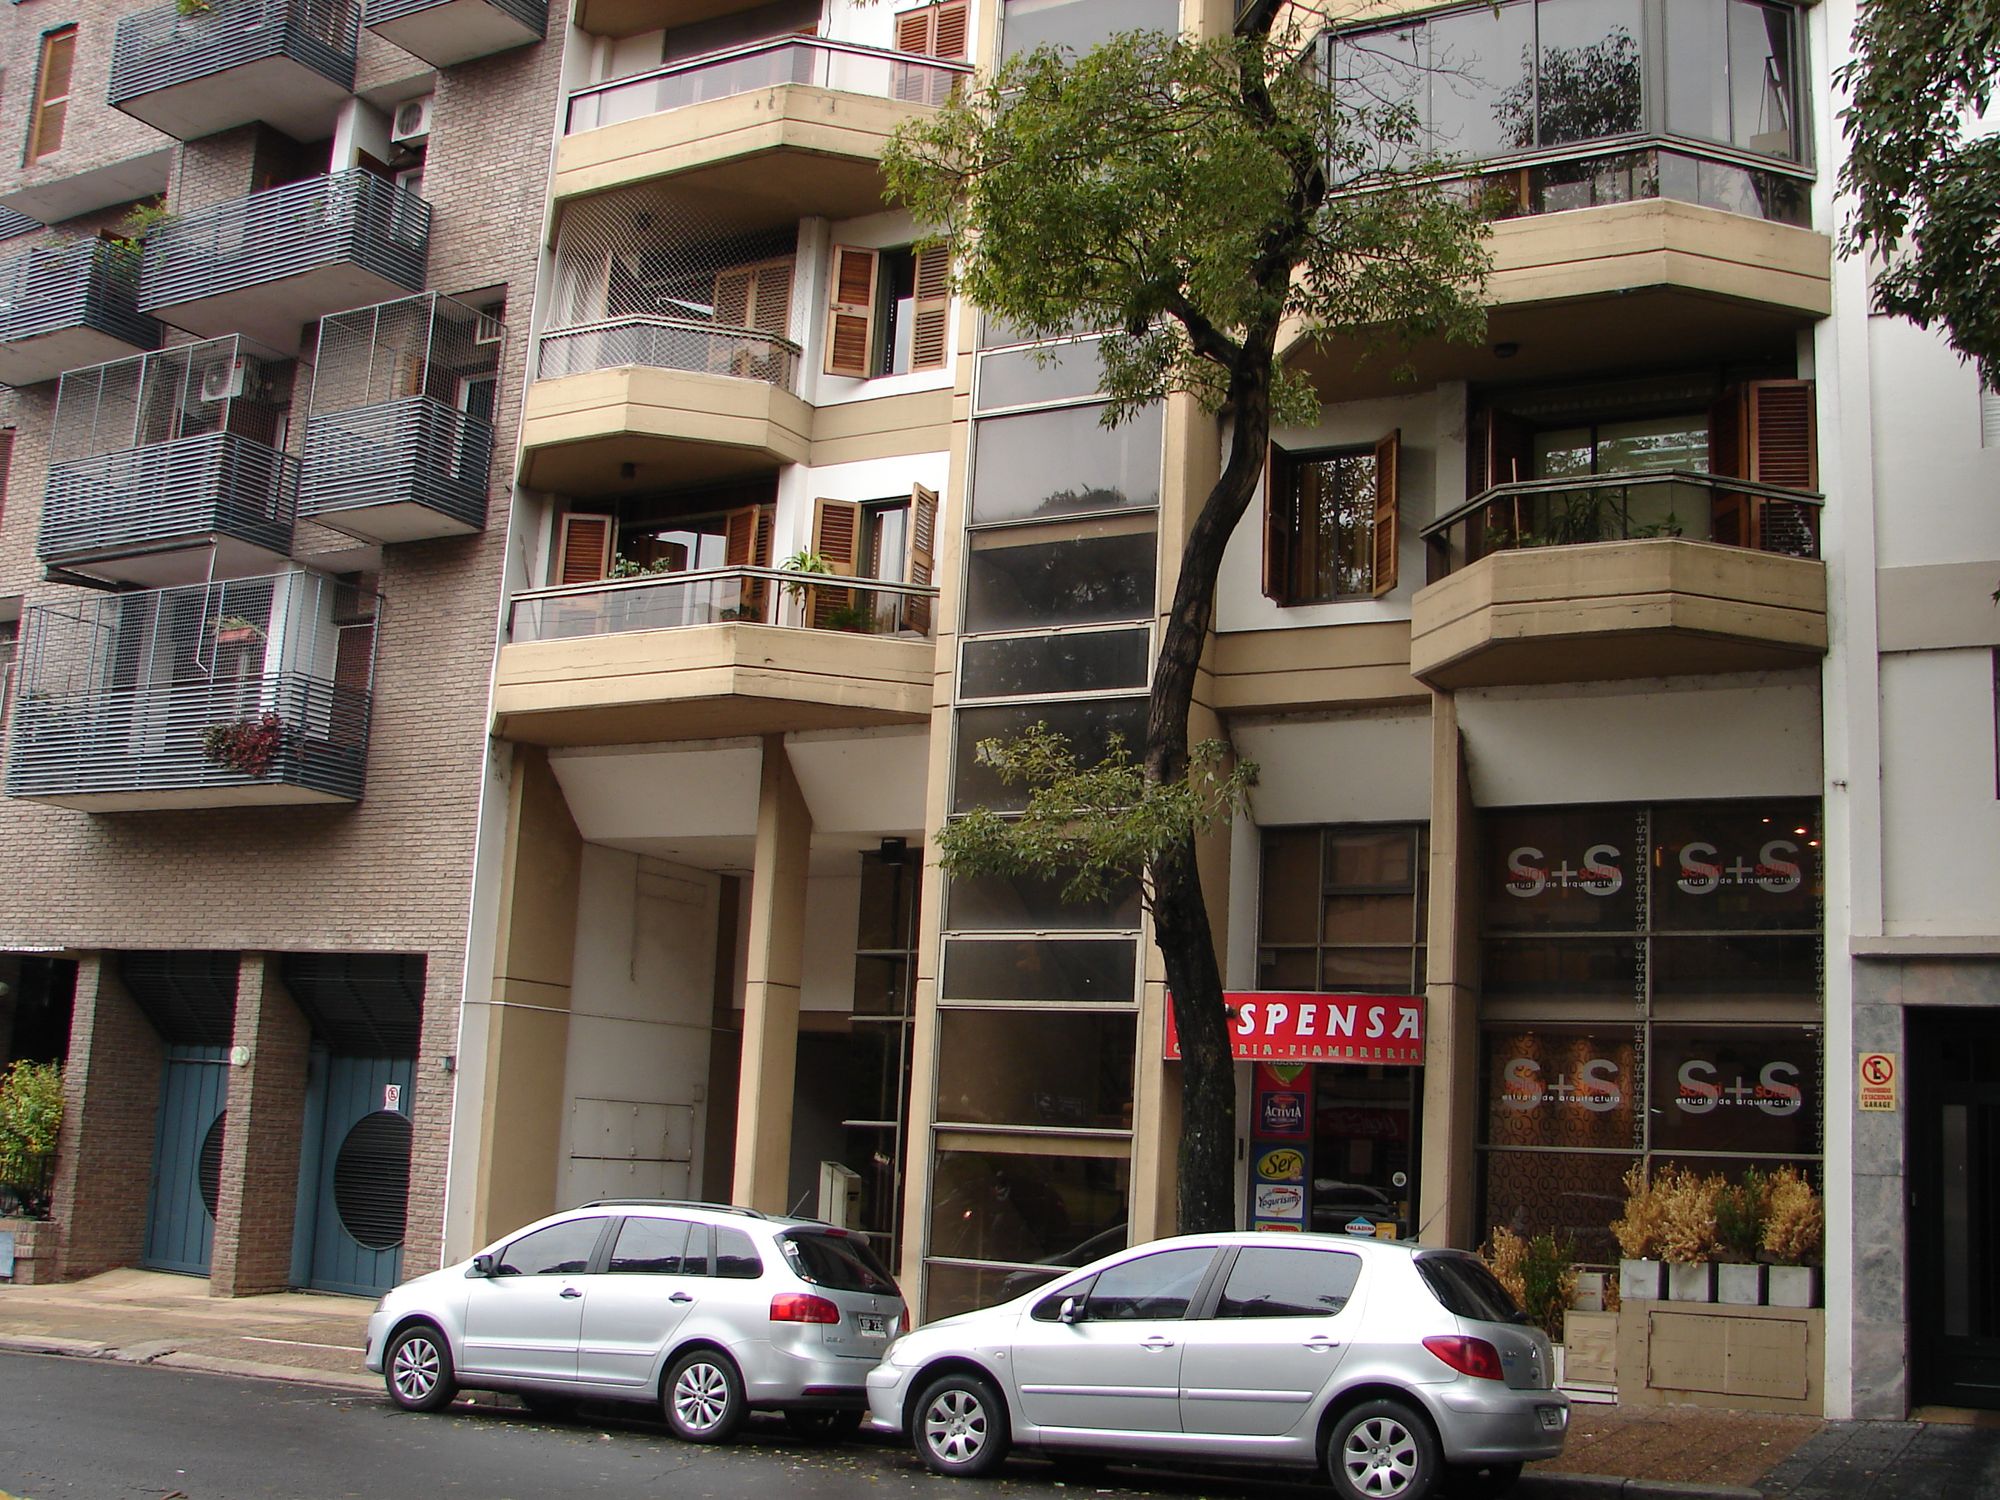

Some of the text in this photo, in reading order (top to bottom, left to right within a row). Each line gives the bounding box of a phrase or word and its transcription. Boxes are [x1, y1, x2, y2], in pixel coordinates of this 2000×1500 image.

[1506, 844, 1622, 897] S+S
[1677, 840, 1800, 894] S+S
[1562, 880, 1622, 888] arquitectura
[1737, 877, 1800, 885] arquitectura
[1225, 1003, 1419, 1039] SPENSA
[1503, 1058, 1621, 1111] S+S
[1677, 1060, 1801, 1116] S+S
[1559, 1094, 1620, 1103] arquitectura
[1676, 1097, 1800, 1106] estudio de arquitectura
[1265, 1105, 1301, 1118] ACTIVIA
[1266, 1154, 1297, 1174] Ser
